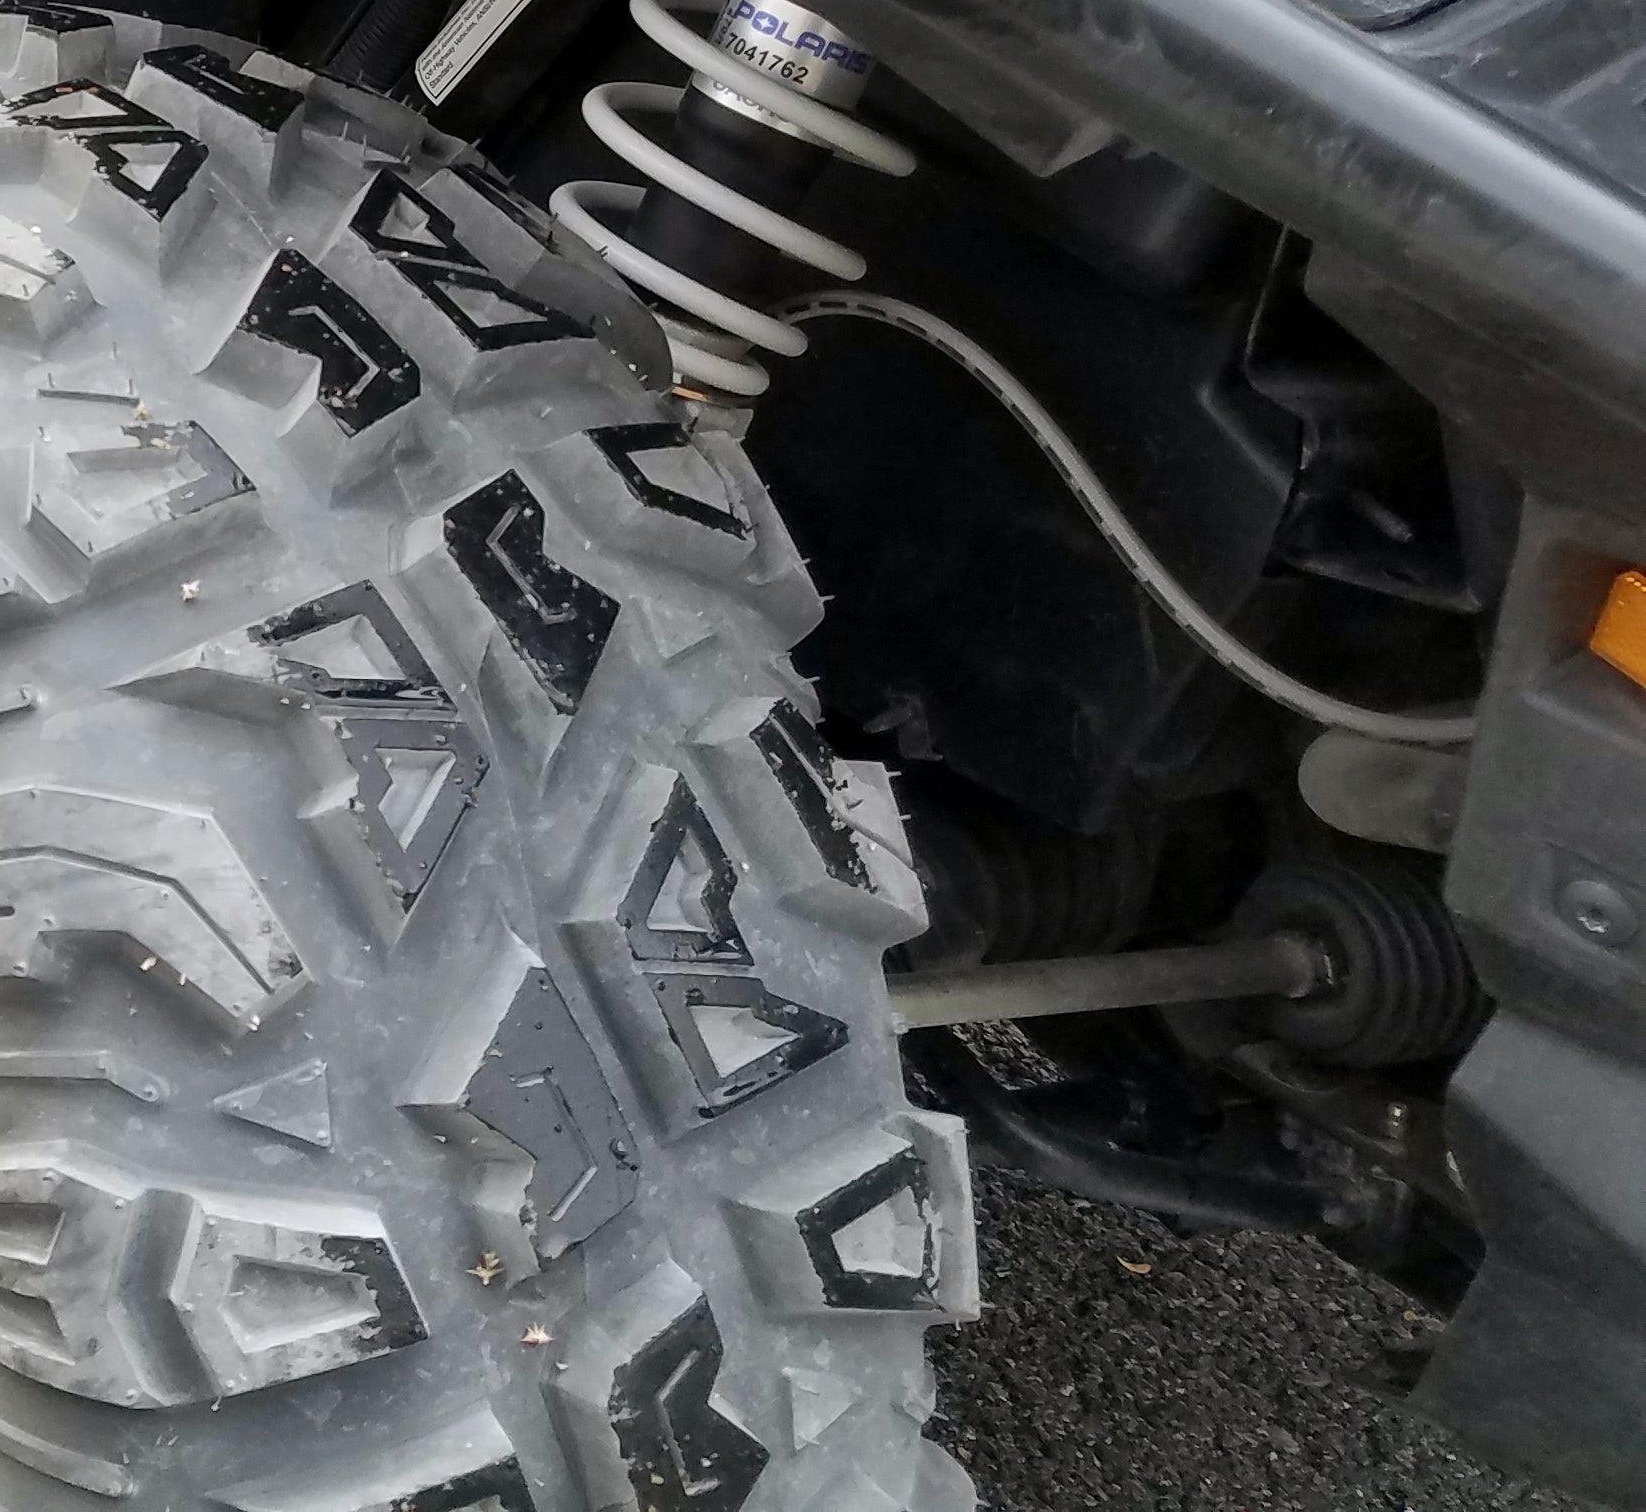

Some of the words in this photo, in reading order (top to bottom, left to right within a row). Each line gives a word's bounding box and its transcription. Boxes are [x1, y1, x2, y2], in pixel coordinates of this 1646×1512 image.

[725, 33, 810, 85] 7041762
[734, 0, 868, 75] POLARIS
[428, 60, 454, 89] Standard
